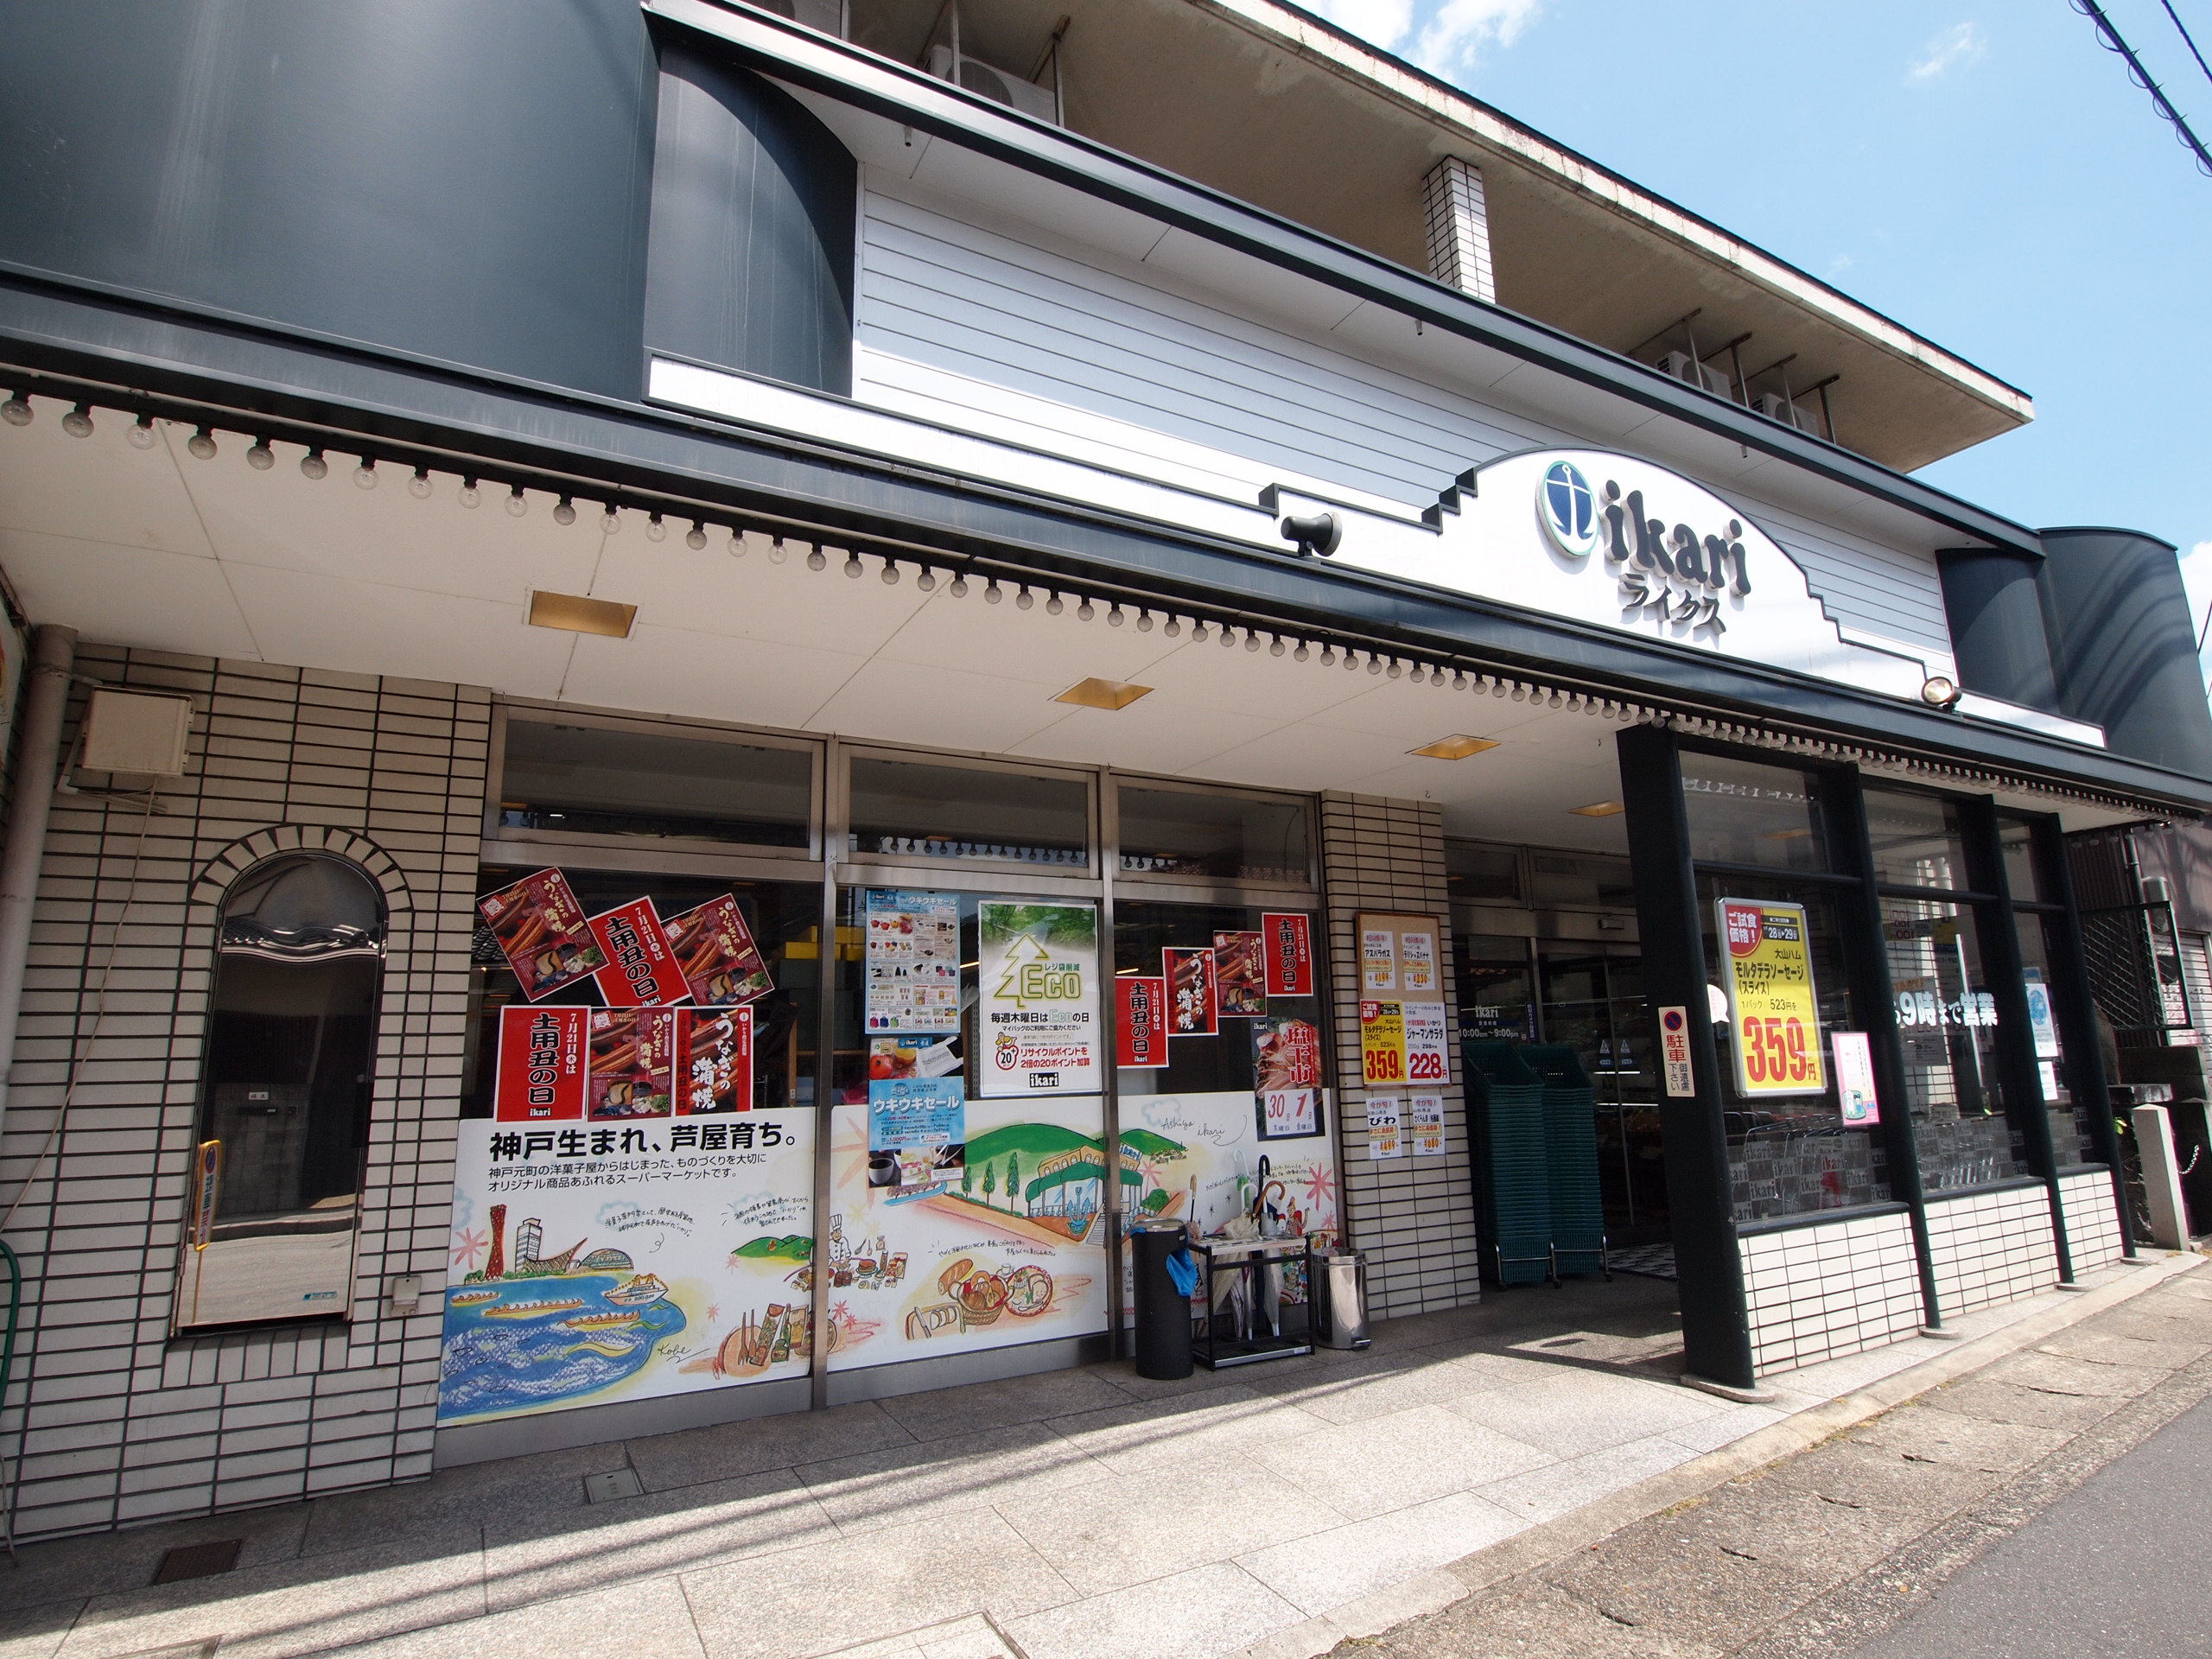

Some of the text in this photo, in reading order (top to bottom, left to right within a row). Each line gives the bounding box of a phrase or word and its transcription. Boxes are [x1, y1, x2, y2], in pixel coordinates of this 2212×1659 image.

[1601, 480, 1751, 597] ikari
[1619, 573, 1726, 635] ライクス
[543, 880, 569, 918] うなぎの
[908, 896, 957, 906] ウキウキセール
[719, 907, 741, 944] うなぎの
[1728, 912, 1757, 928] ご試食
[1729, 928, 1756, 944] 価格!
[606, 916, 658, 998] 土用丑の日
[1279, 918, 1296, 983] 土用丑の日
[1775, 949, 1802, 960] 大山ハム
[1020, 964, 1081, 999] Eco
[1191, 953, 1205, 1015] うなぎの
[1735, 962, 1804, 981] モルタデラソーセージ
[1739, 980, 1770, 995] (スライス)
[642, 995, 661, 1007] ikari
[1177, 988, 1194, 1029] 蒲焼
[1475, 1005, 1499, 1018] ikari
[1742, 998, 1797, 1011] 1パック 523円を
[1130, 982, 1149, 1052] 土用丑の日
[652, 1015, 664, 1058] うなぎの
[1407, 1028, 1443, 1039] ジャーマンサラダ
[528, 1012, 561, 1104] 土用丑の日
[715, 1013, 735, 1090] うなぎの
[1020, 1046, 1088, 1057] リサイクルポイントを
[1287, 1027, 1312, 1084] 塩干市
[1667, 1034, 1686, 1063] 駐車
[1743, 1016, 1816, 1083] 359円
[1020, 1058, 1090, 1069] 2倍の20ポイント加算
[692, 1057, 718, 1109] 蒲焼
[1030, 1073, 1058, 1087] ikari
[1669, 1064, 1680, 1090] 下さい
[1679, 1064, 1690, 1090] 御遠慮
[530, 1108, 550, 1116] ikari
[874, 1096, 961, 1116] ウキウキセール
[1161, 1117, 1195, 1130] Ashiya
[1198, 1123, 1225, 1137] ikari
[1370, 1116, 1396, 1126] びわ
[490, 1122, 795, 1162] 神戸生まれ、芦屋育ち。
[488, 1153, 766, 1179] 神戸元町の洋菓子屋からはじまった、ものづくりを大切に
[488, 1168, 737, 1192] オリジナル商品あふれるスーパーマーケットです。
[1751, 1181, 1776, 1199] ikari
[657, 1344, 691, 1355] Kobe
